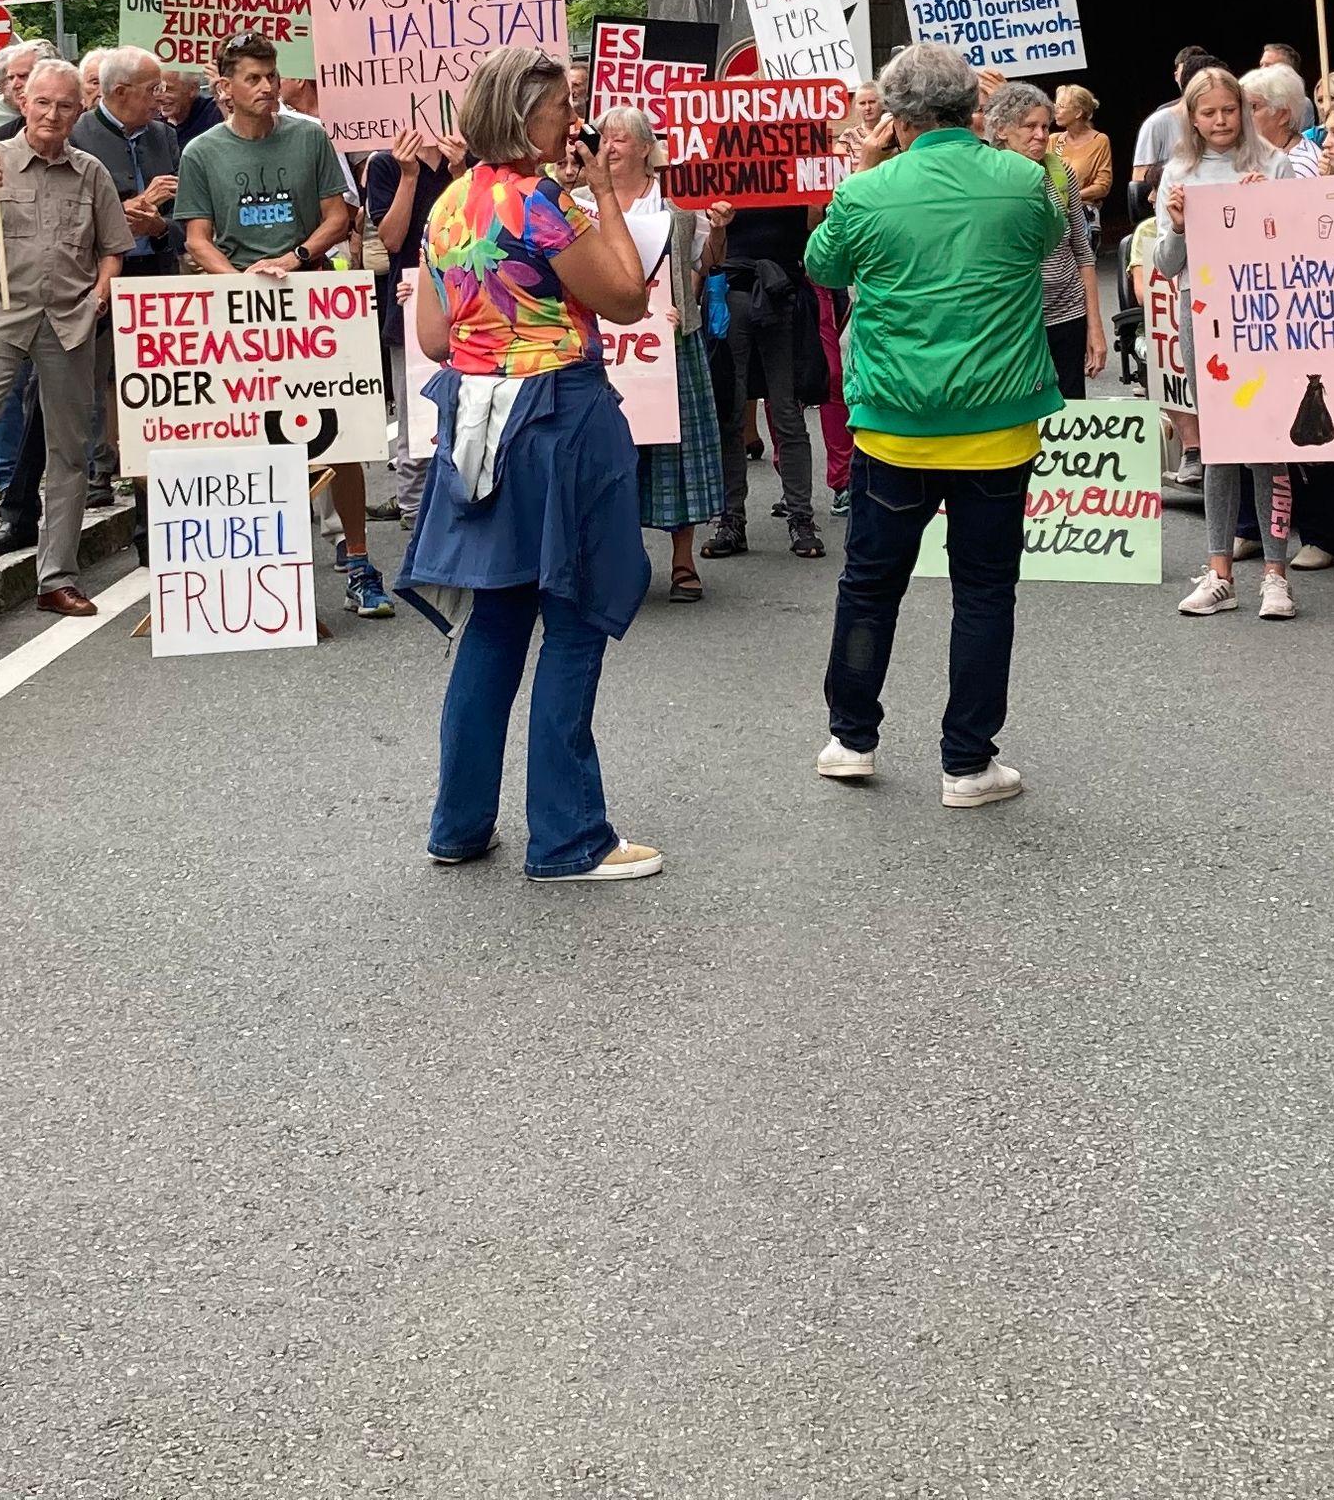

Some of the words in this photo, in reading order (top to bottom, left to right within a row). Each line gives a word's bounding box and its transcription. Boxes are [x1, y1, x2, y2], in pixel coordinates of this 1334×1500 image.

[369, 0, 565, 56] HALLSTATT
[774, 7, 826, 43] FÜR
[951, 20, 992, 45] 700
[599, 27, 640, 60] ES
[765, 39, 856, 81] NICHTS
[596, 61, 705, 95] REICHT
[668, 84, 846, 125] TOURISMUS
[796, 156, 851, 192] NEIN
[239, 203, 294, 227] GREECE
[1228, 262, 1277, 292] VIEL
[118, 292, 215, 334] JETZT
[229, 288, 298, 324] EINE
[1231, 294, 1279, 322] UND
[137, 326, 337, 368] BREMSUNG
[1234, 323, 1279, 352] FÜR
[120, 371, 216, 409] ODER
[223, 368, 282, 404] wir
[285, 372, 383, 400] werden
[143, 412, 260, 443] überrollt
[157, 465, 287, 508] WIRBEL
[154, 511, 297, 562] TRUBEL
[157, 562, 314, 635] FRUST
